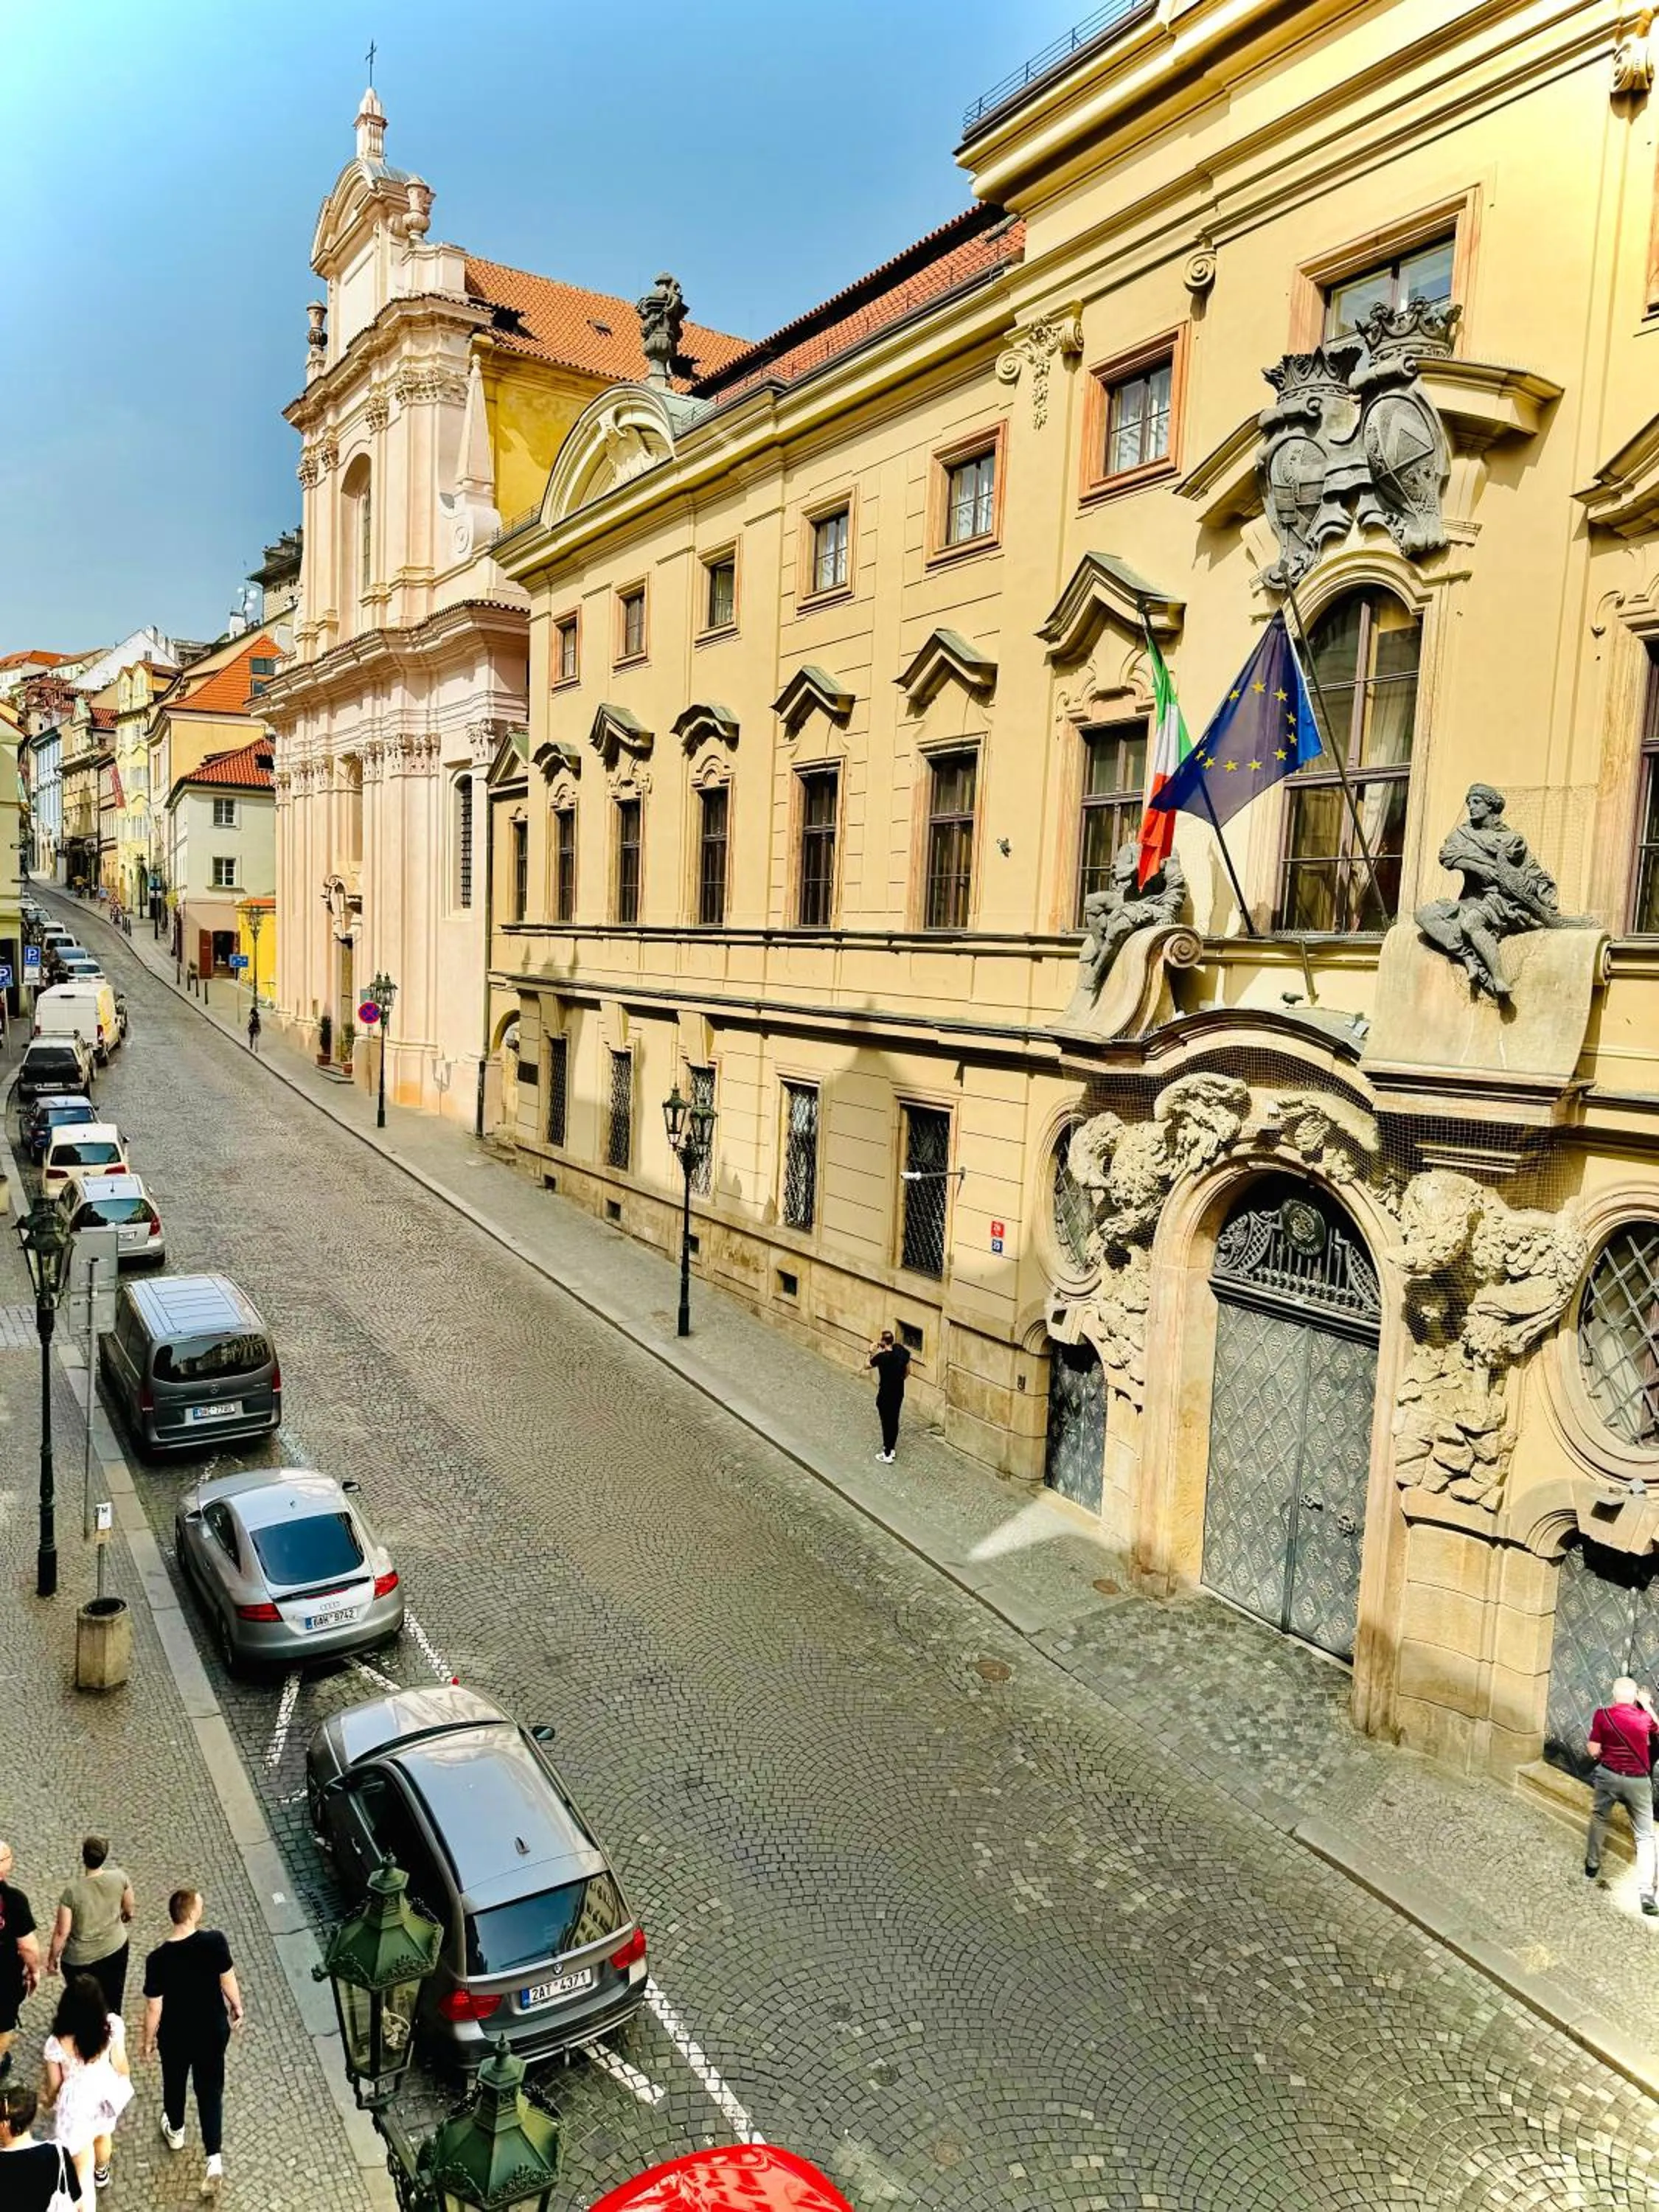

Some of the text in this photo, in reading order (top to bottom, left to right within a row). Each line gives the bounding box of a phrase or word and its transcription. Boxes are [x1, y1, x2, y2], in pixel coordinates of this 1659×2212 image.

[27, 949, 38, 961] P
[532, 1971, 586, 2000] 2AT 4371
